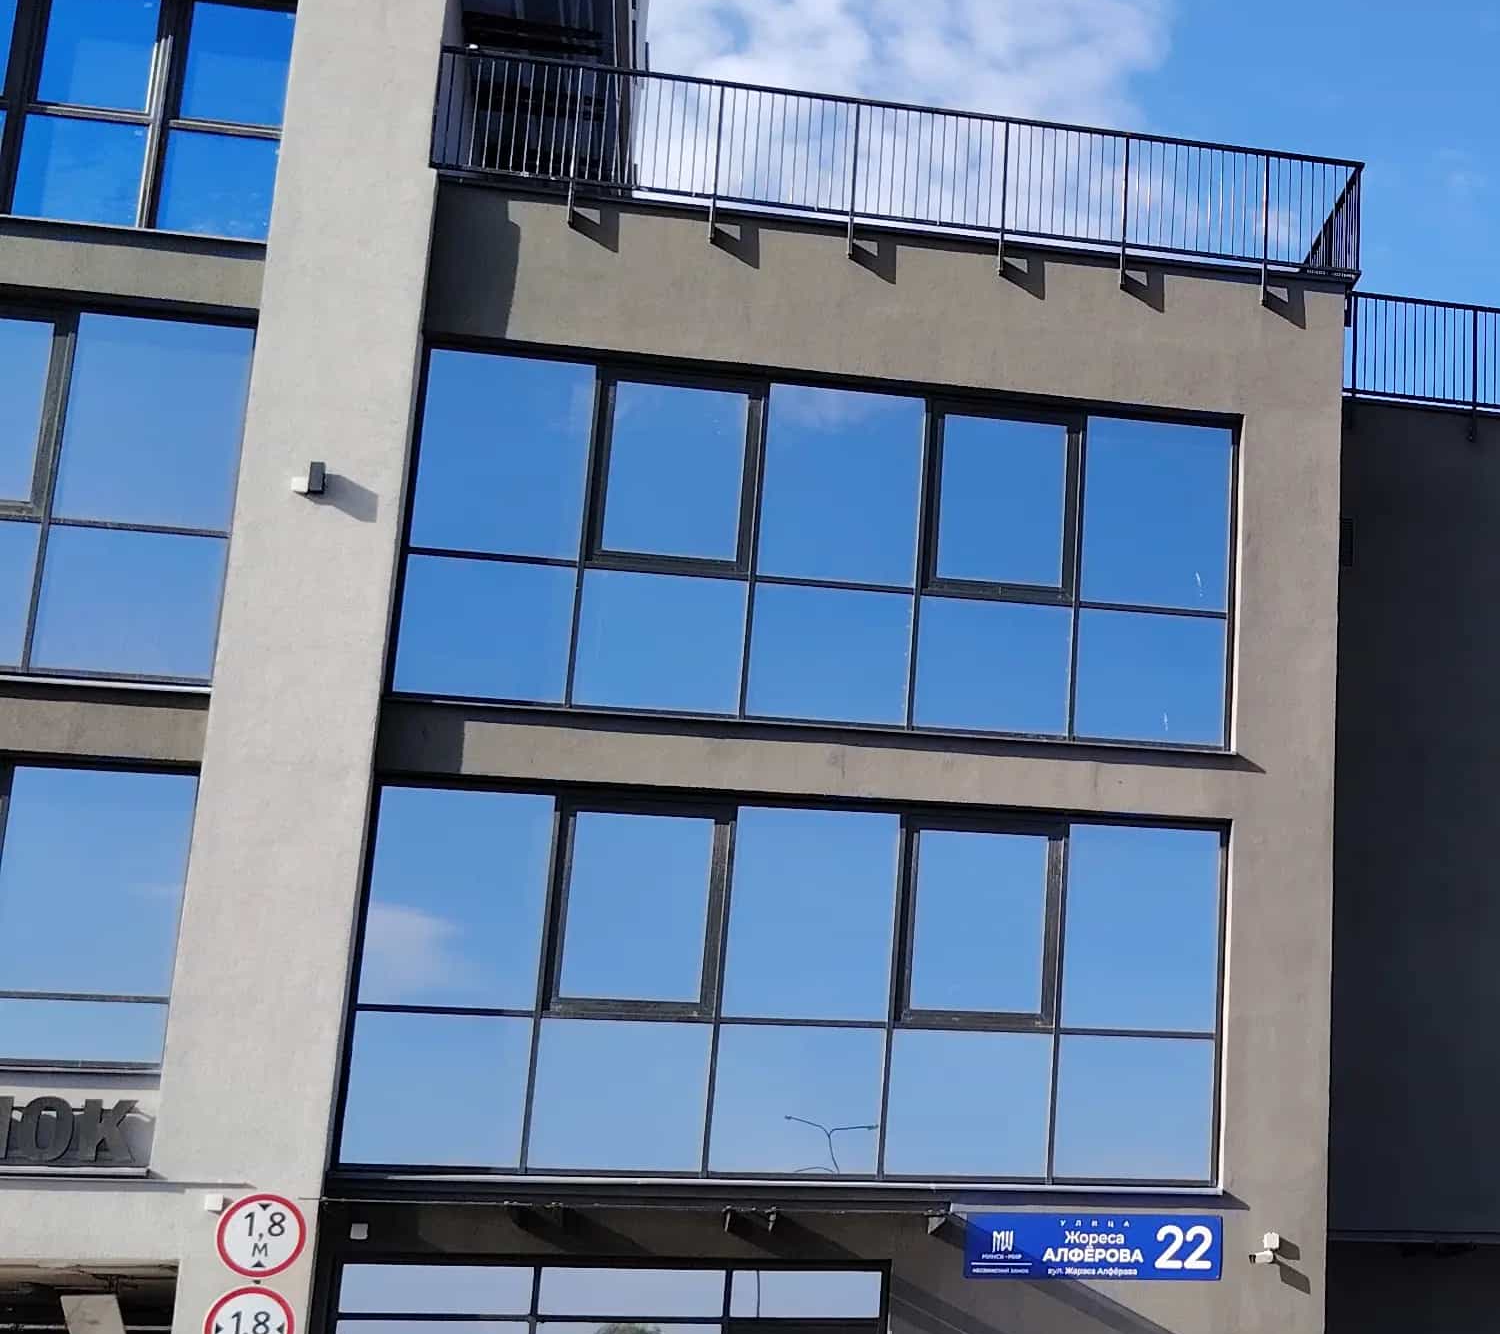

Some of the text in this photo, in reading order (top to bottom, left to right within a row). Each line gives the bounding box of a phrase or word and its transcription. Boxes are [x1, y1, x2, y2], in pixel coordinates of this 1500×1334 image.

[244, 1211, 286, 1241] 1,8
[1060, 1220, 1130, 1228] УЛИЦА
[1064, 1230, 1125, 1246] Жореса
[1154, 1224, 1213, 1269] 22
[1042, 1245, 1144, 1263] АЛФЁРОВА
